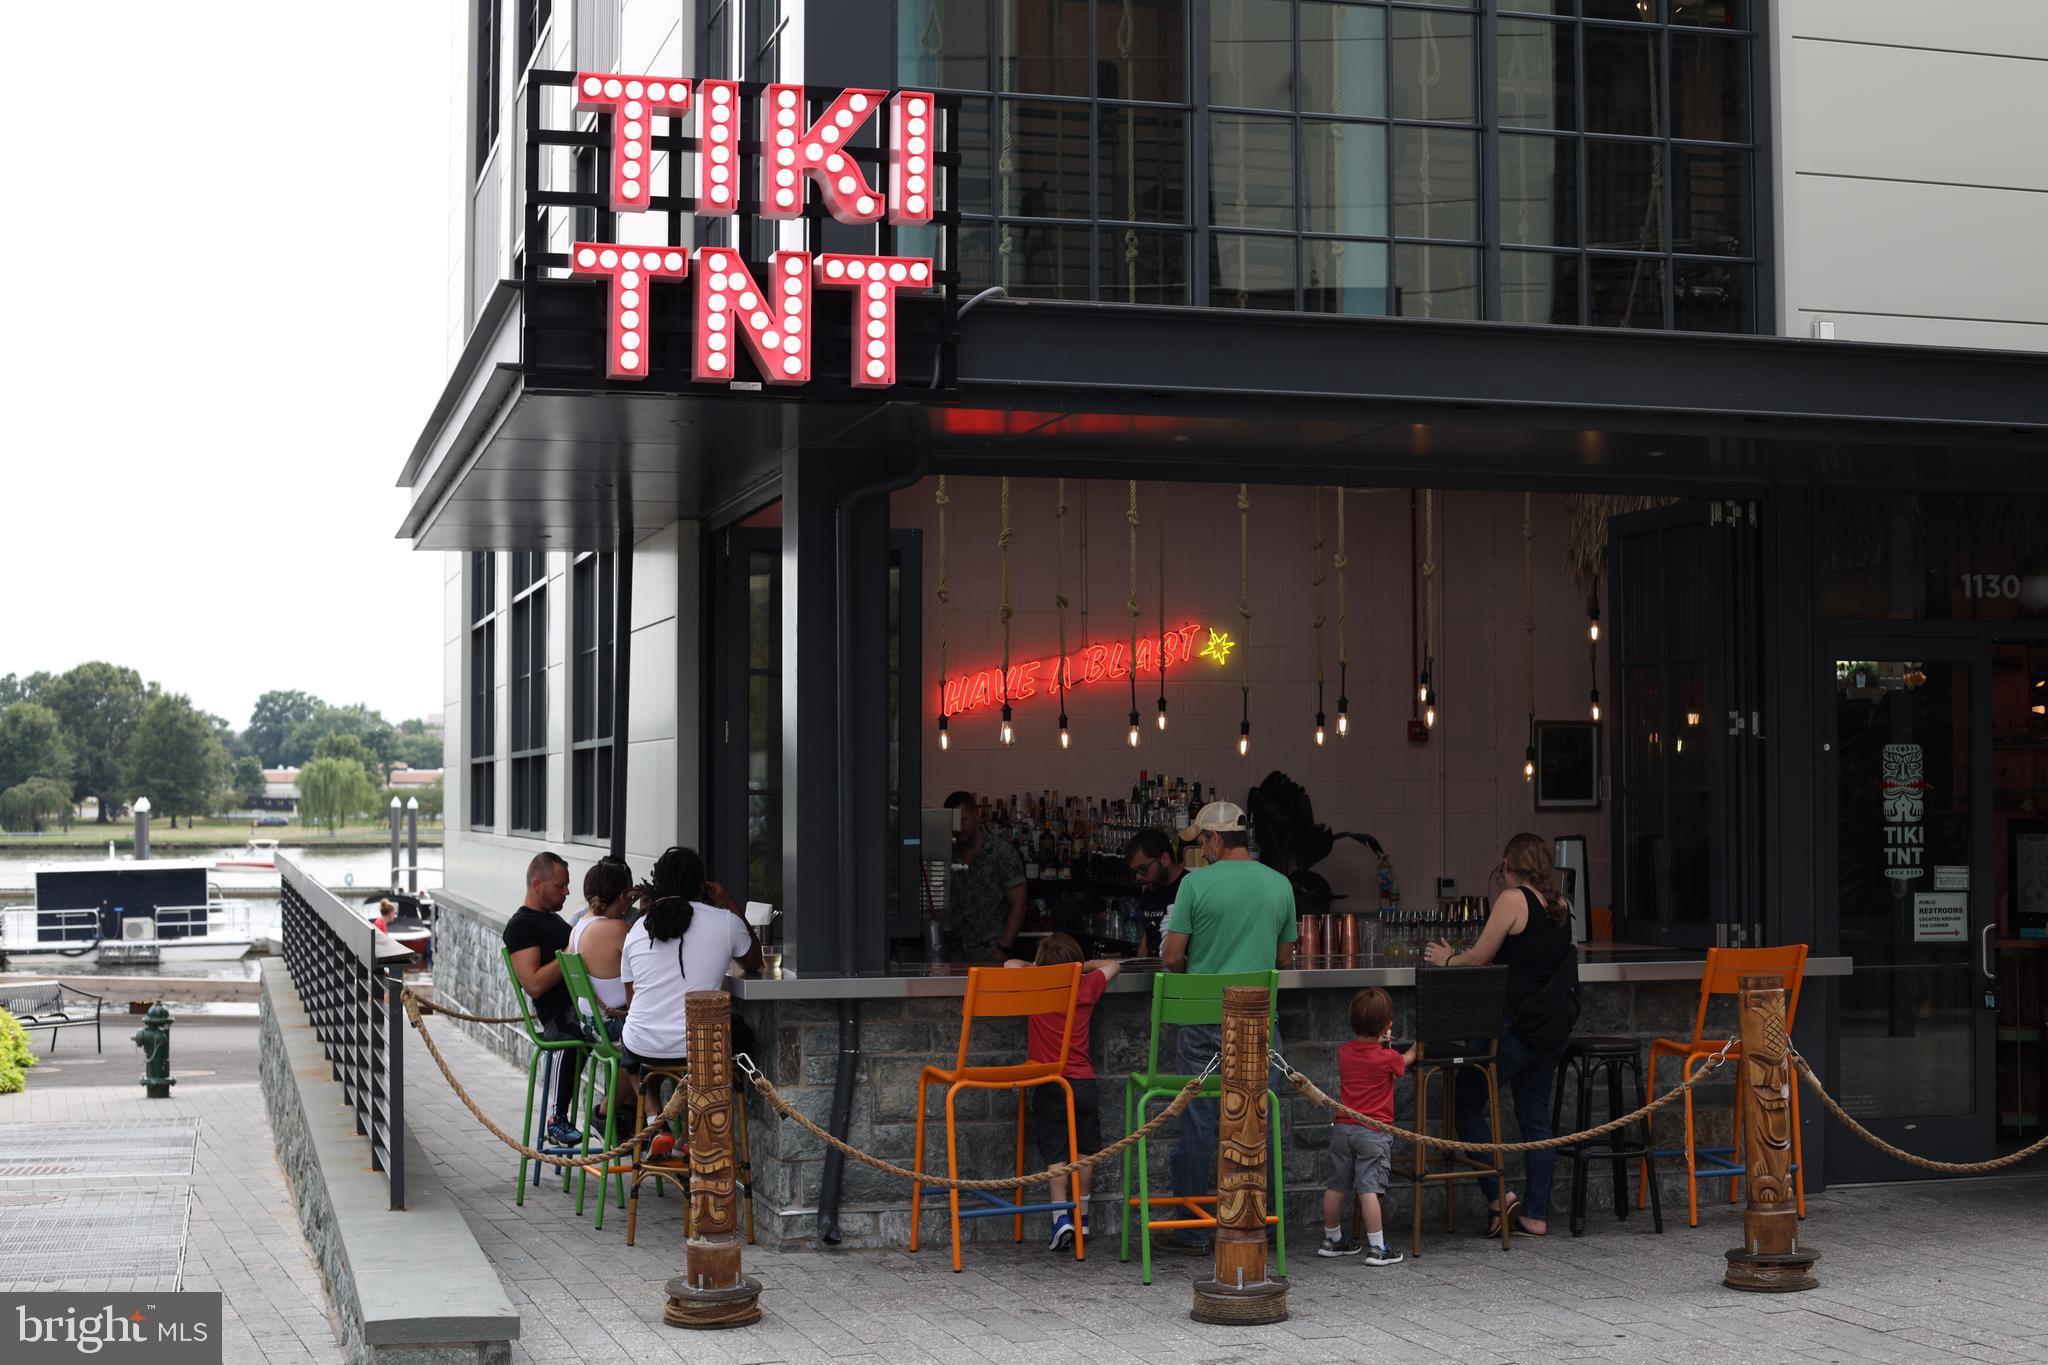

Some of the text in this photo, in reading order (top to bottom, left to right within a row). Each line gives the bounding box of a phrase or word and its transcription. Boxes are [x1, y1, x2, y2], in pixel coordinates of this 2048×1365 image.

[573, 72, 935, 226] TIKI
[568, 241, 933, 390] TNT
[1960, 573, 2021, 599] 1130
[943, 624, 1201, 717] HAVE A BLAST
[1883, 826, 1924, 844] TIKI
[1883, 847, 1924, 865] TNT
